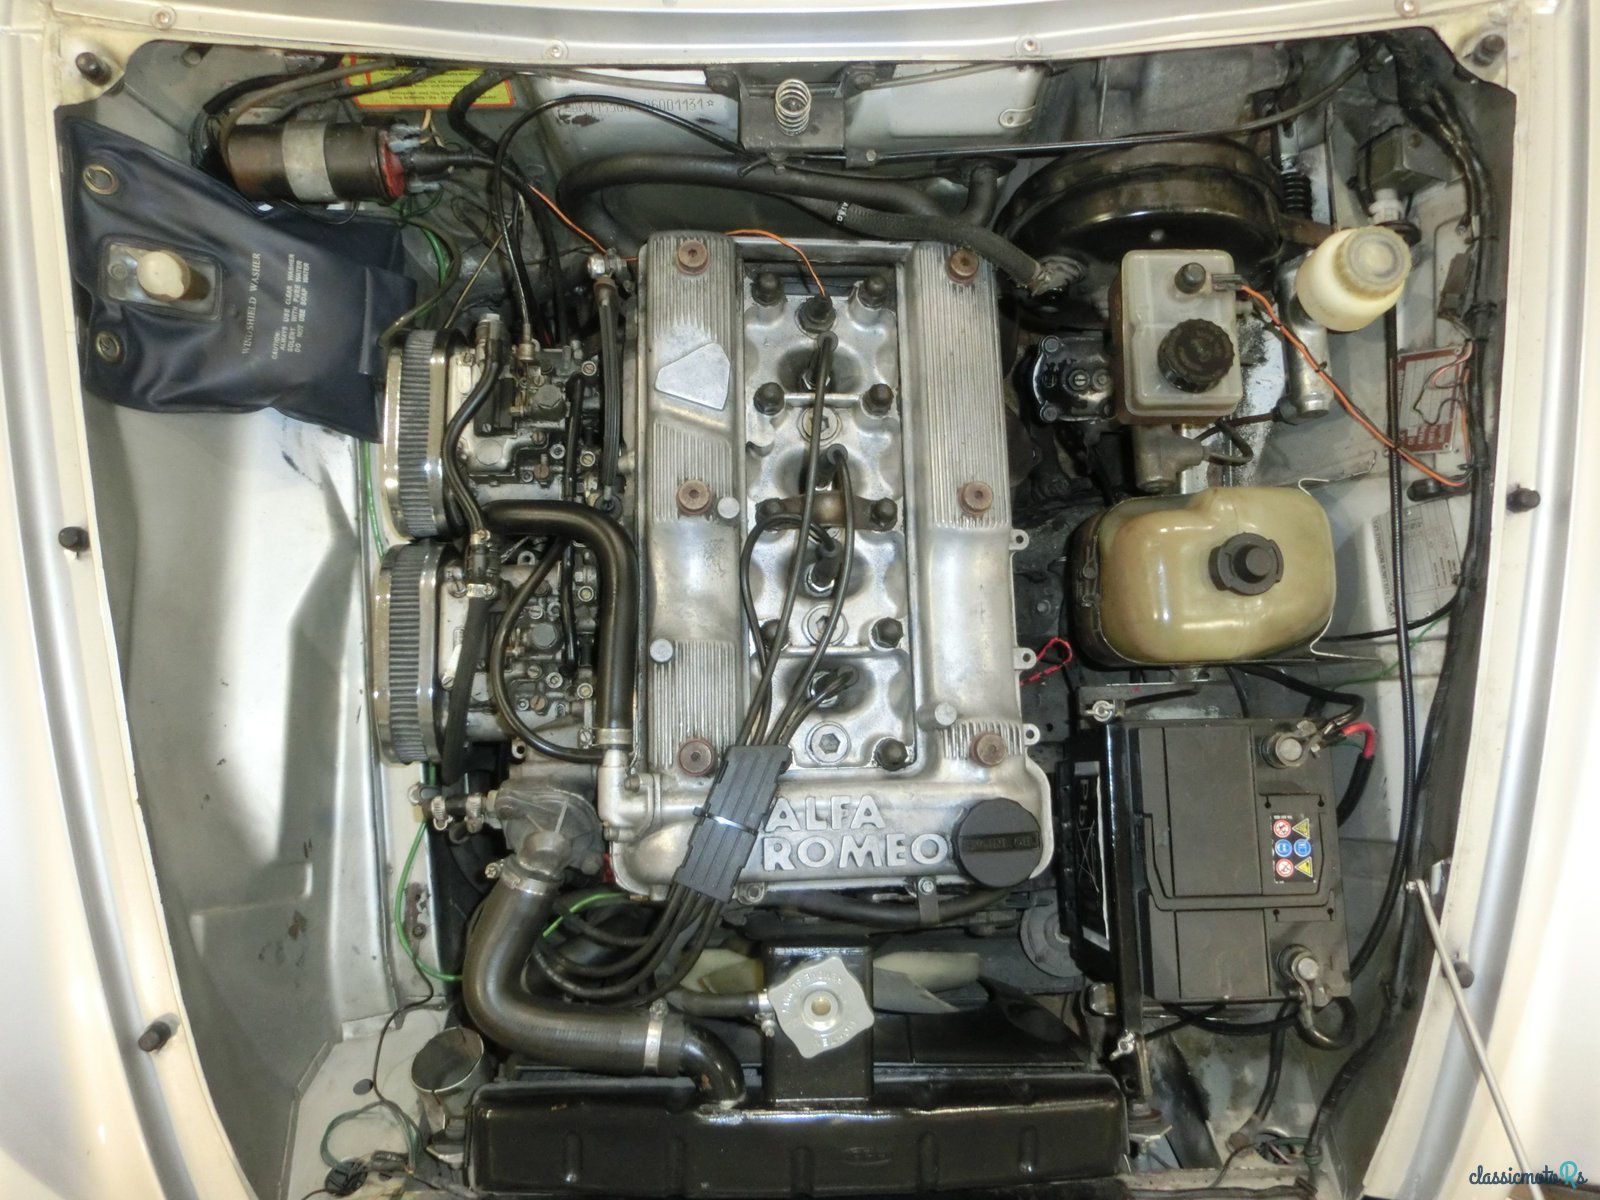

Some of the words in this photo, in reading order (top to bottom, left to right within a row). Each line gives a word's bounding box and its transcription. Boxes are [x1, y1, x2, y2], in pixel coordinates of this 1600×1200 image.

[287, 253, 295, 281] WASHER
[295, 260, 303, 282] WATER
[302, 262, 310, 283] WATER
[242, 296, 257, 354] WINDSHIELD
[250, 253, 261, 291] WASHER
[285, 285, 293, 305] CLEAR
[293, 284, 301, 302] PURE
[300, 287, 308, 306] SOAP
[298, 308, 306, 322] USE
[765, 795, 886, 832] ALFA
[763, 833, 949, 871] ROMEO
